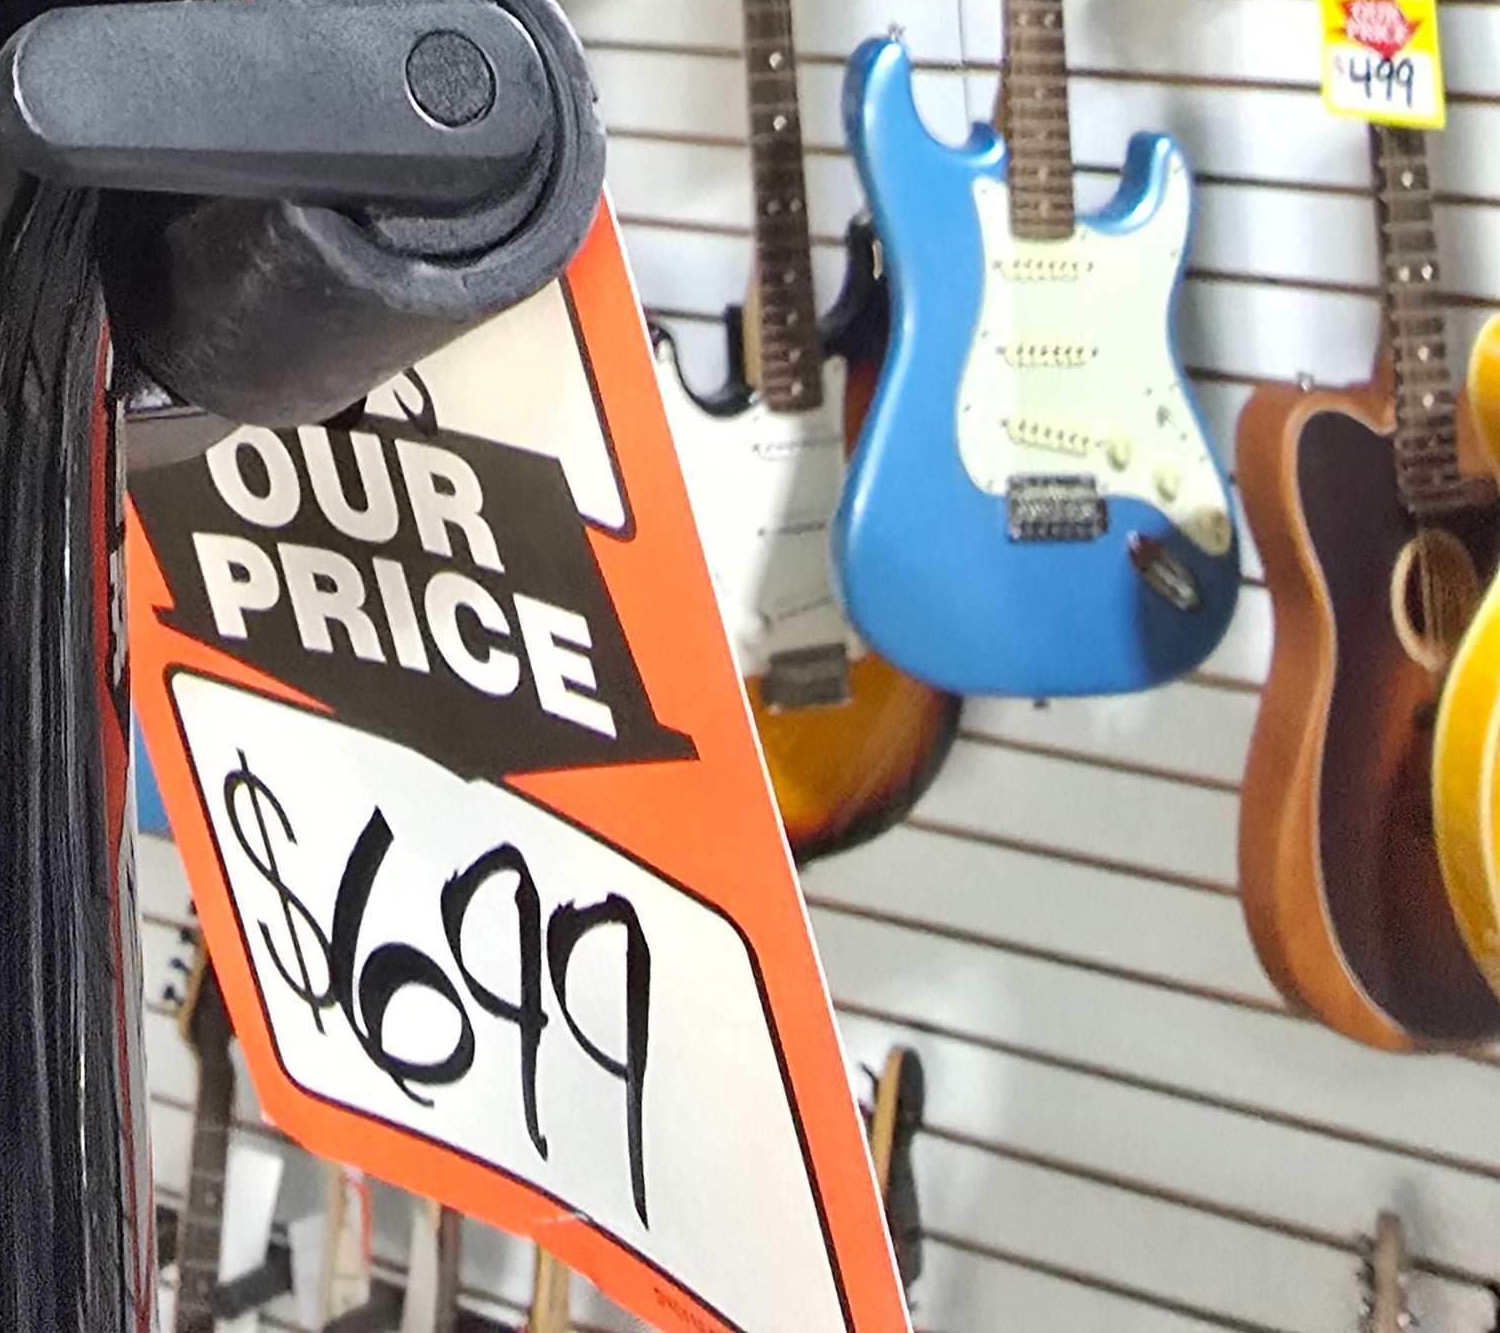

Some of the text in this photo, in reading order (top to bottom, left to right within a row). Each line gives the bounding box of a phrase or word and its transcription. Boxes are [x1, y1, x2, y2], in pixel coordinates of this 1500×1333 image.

[206, 423, 506, 576] OUR
[192, 532, 617, 738] PRICE
[223, 747, 651, 1231] $699
